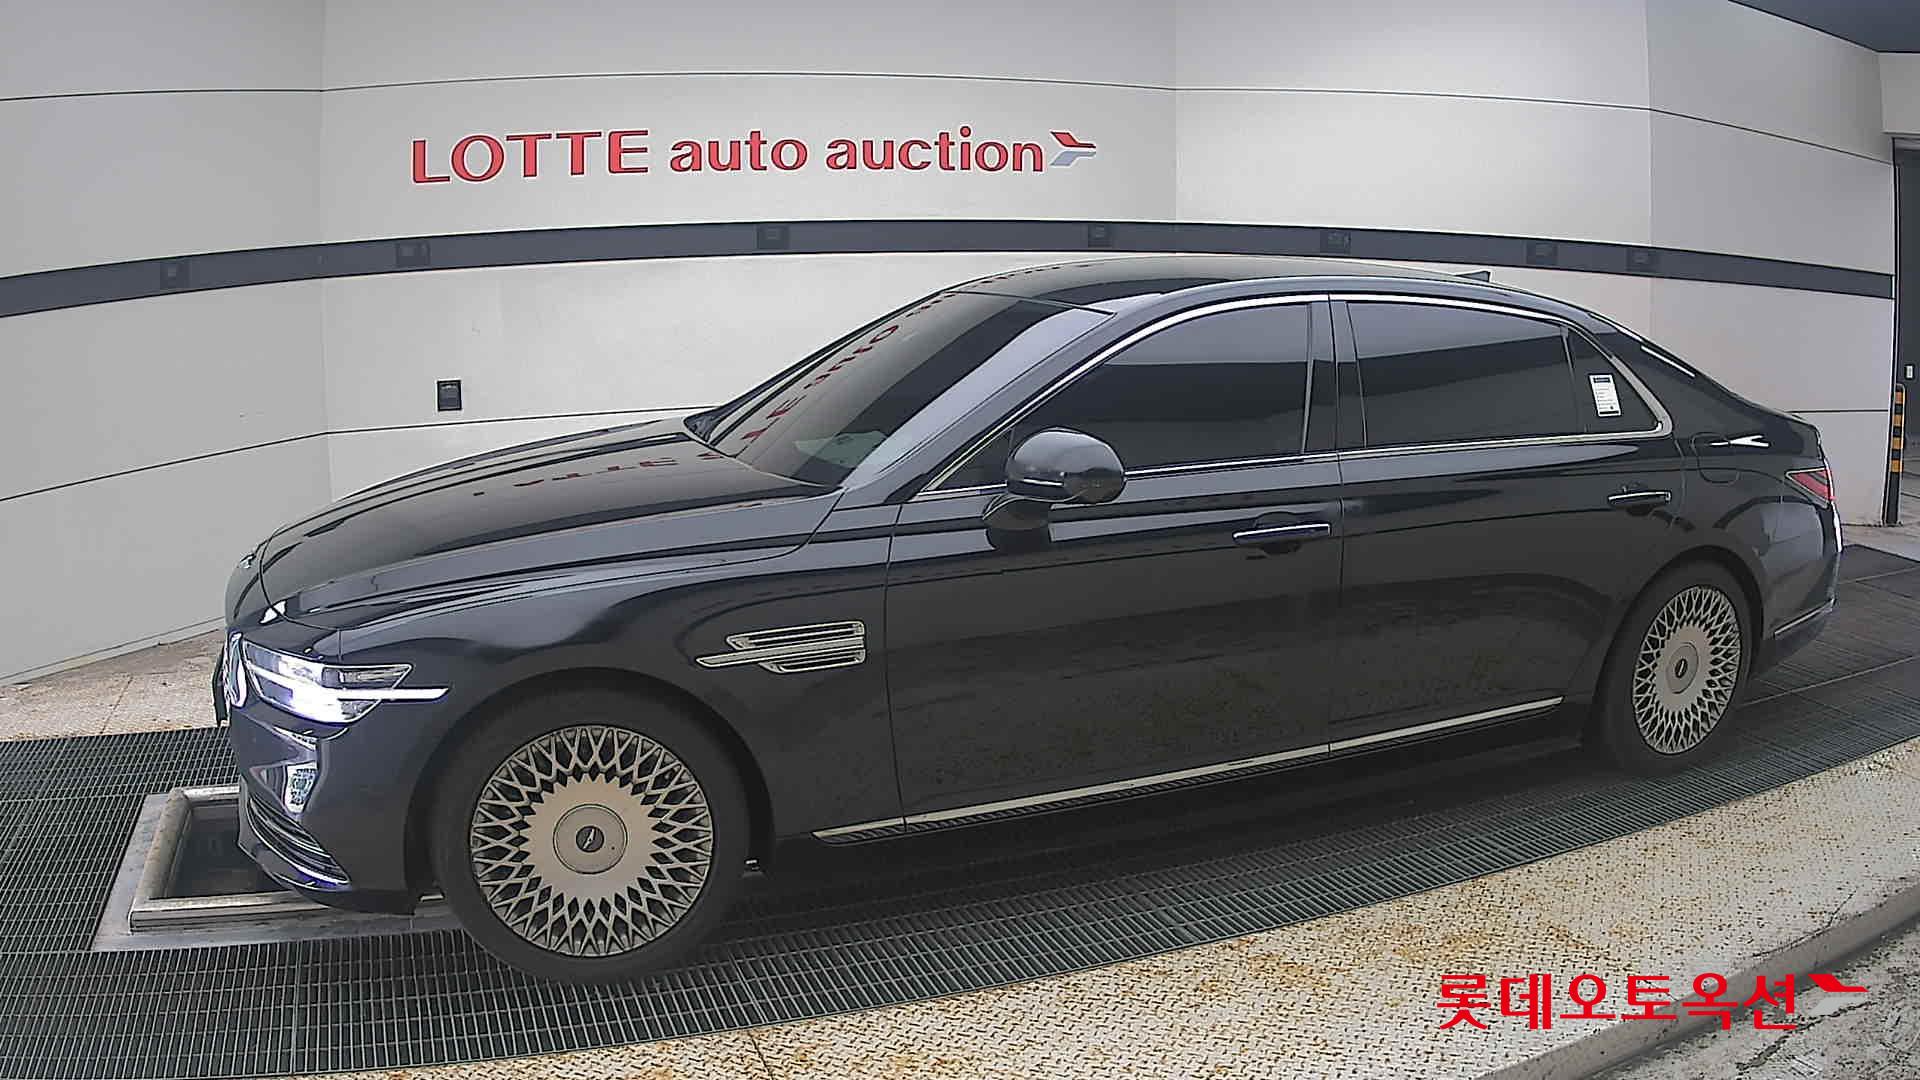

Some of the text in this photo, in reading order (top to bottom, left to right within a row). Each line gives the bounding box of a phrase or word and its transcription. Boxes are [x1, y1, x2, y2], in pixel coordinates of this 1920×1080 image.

[411, 126, 1044, 184] LOTTE auto auction
